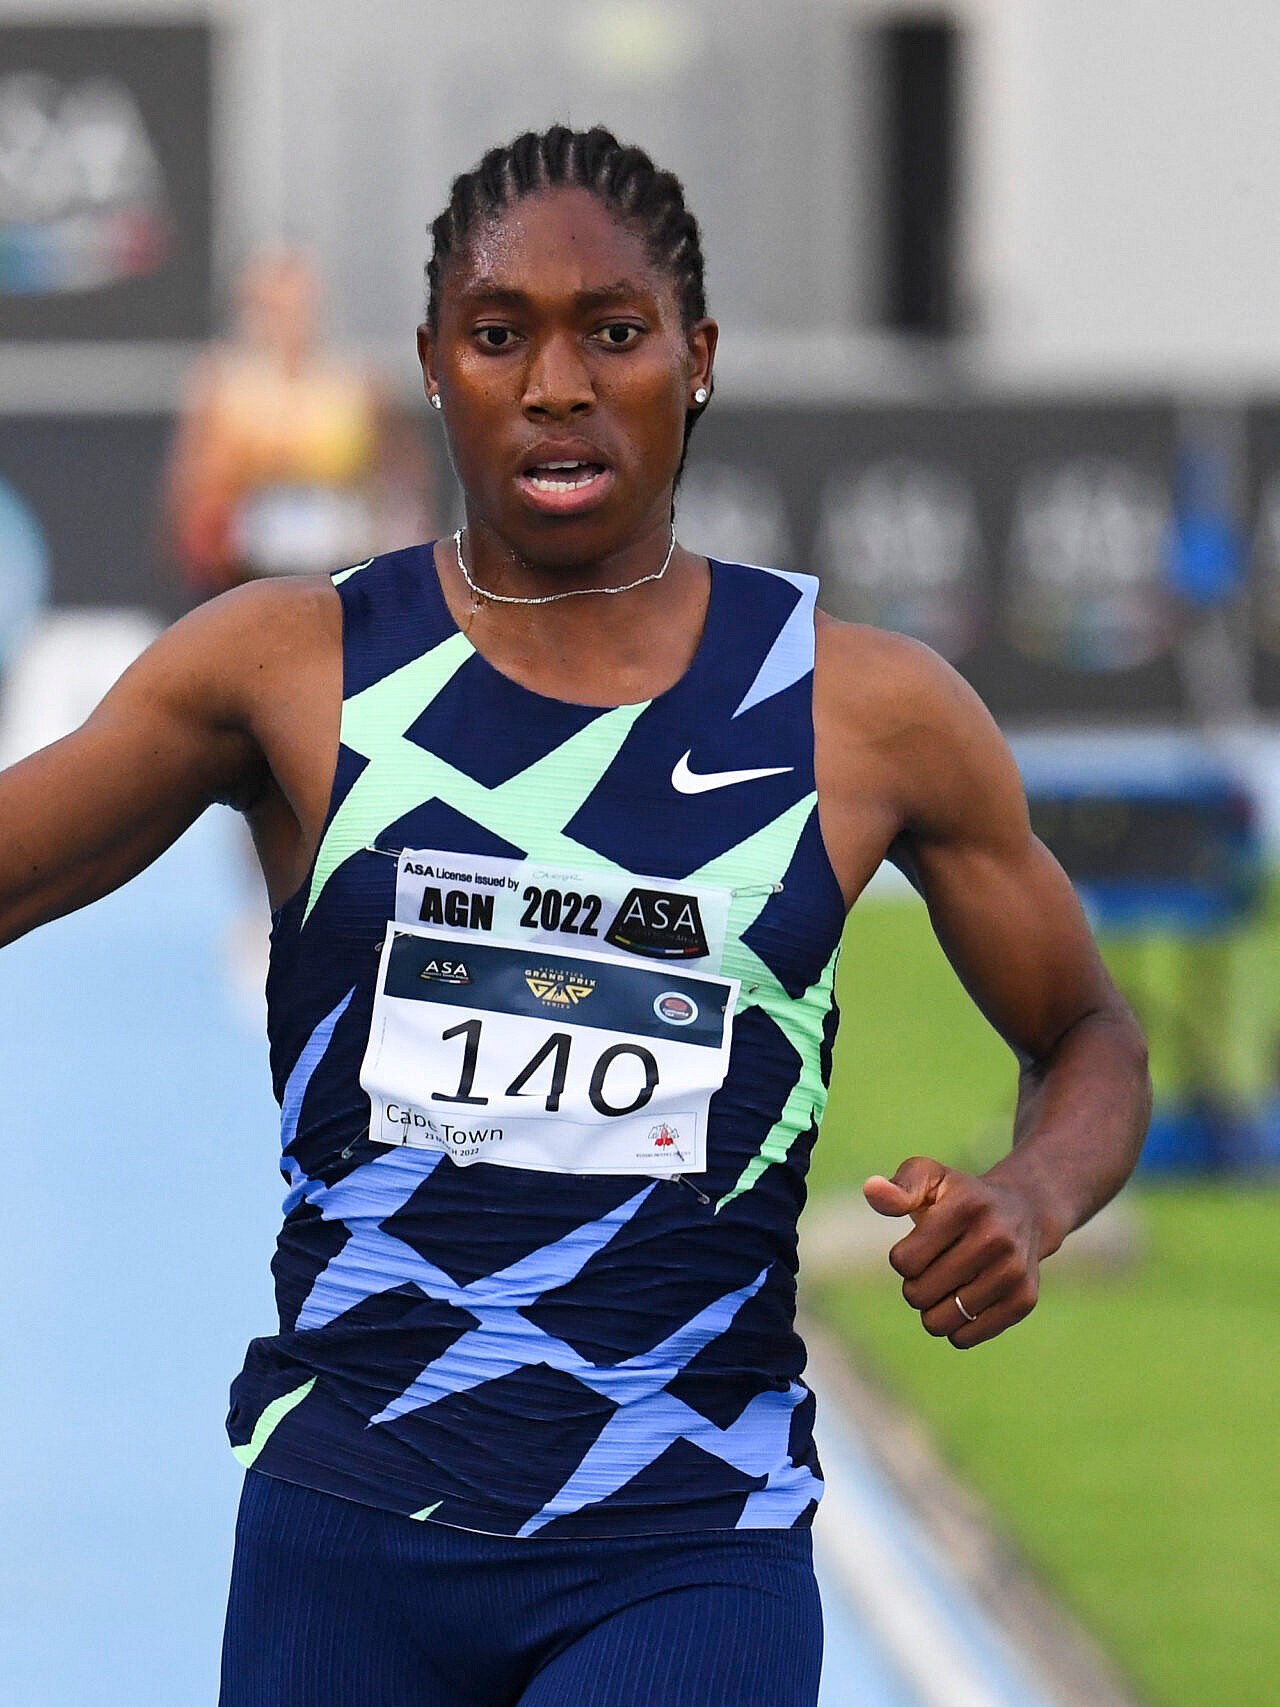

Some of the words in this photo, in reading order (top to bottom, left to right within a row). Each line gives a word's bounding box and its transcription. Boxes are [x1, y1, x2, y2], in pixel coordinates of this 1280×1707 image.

[404, 862, 434, 877] ASA
[436, 868, 472, 883] License
[475, 873, 505, 887] issued
[508, 877, 519, 892] by
[419, 886, 495, 931] AGN
[520, 886, 602, 937] 2022
[623, 896, 696, 934] ASA
[425, 960, 467, 977] ASA
[524, 969, 565, 981] GRAND
[569, 976, 596, 987] PRIX
[431, 1019, 660, 1117] 140
[440, 1124, 503, 1145] Town
